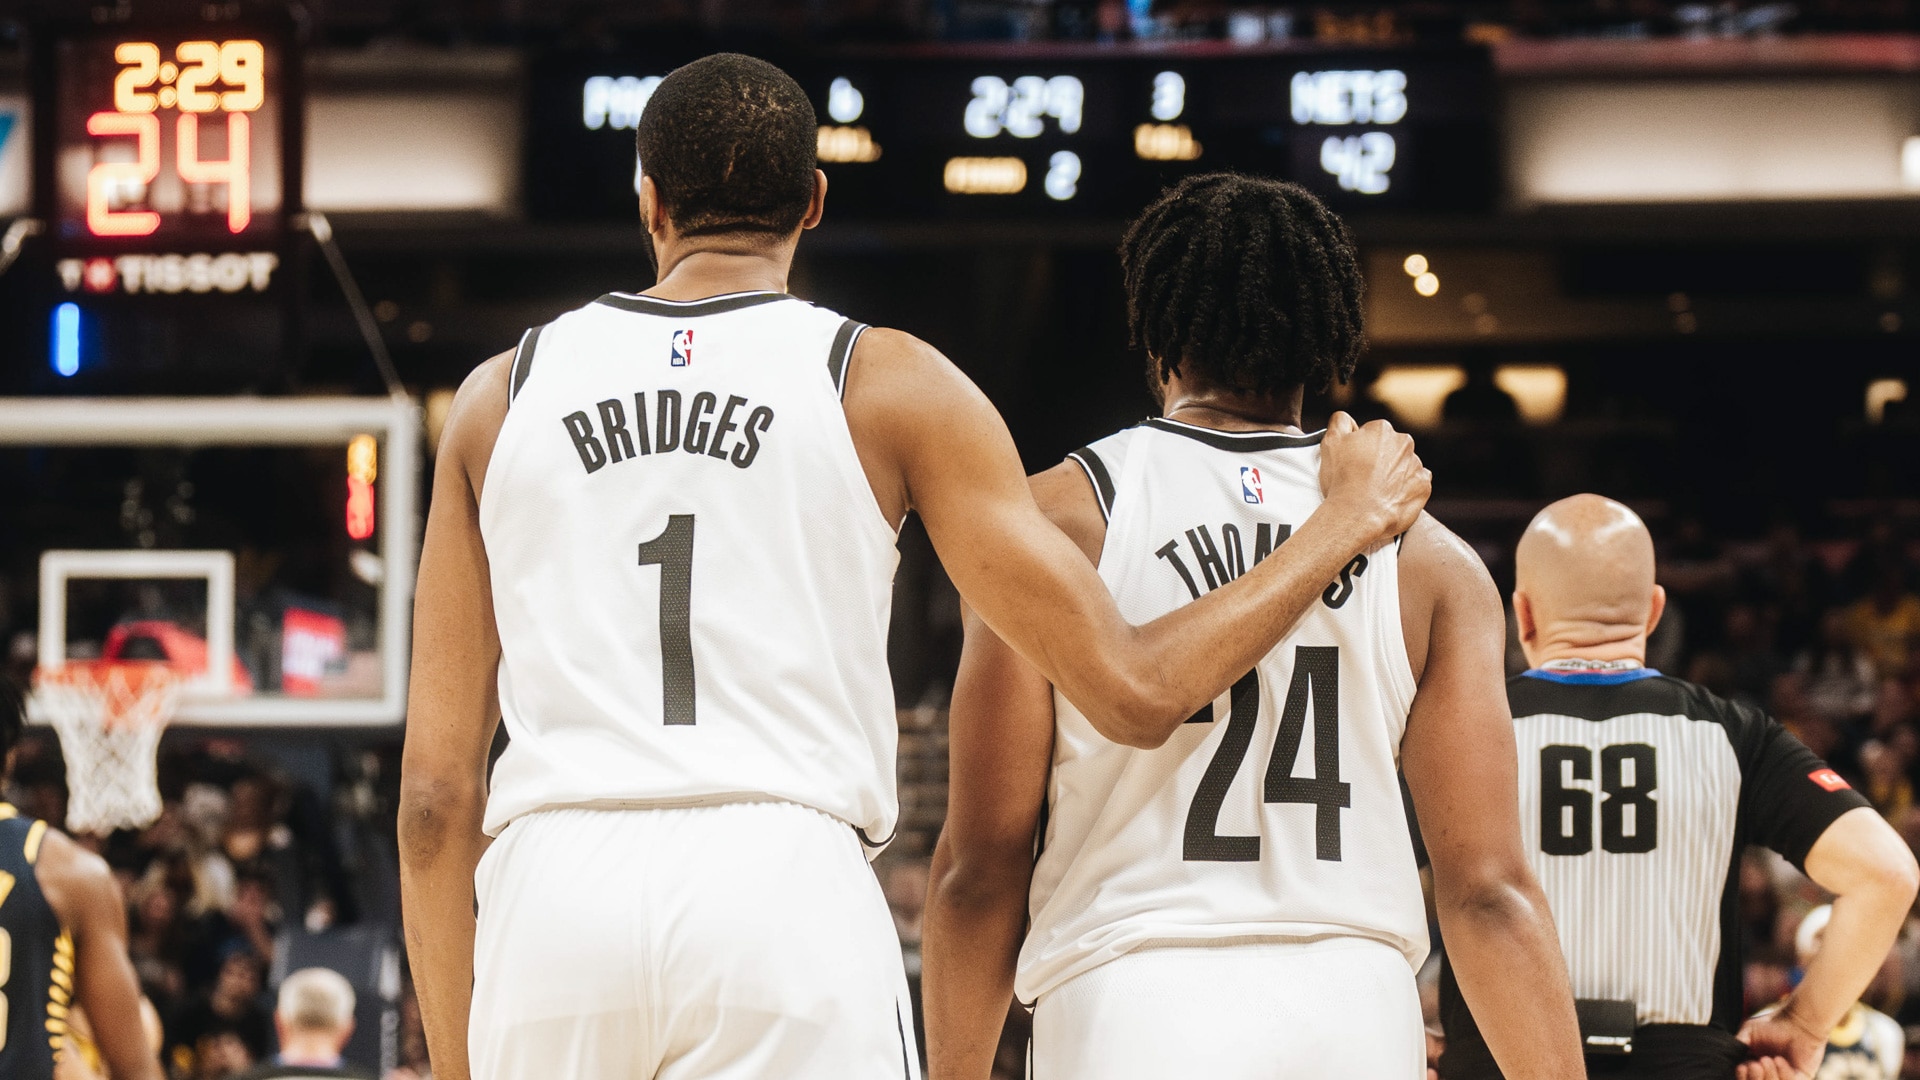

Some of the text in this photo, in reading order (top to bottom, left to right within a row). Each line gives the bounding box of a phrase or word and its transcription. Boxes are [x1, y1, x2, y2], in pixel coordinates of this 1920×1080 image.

[115, 40, 264, 113] 2:29
[964, 75, 1084, 138] 2:29
[1151, 71, 1186, 121] 3
[1290, 70, 1407, 125] NETS
[87, 111, 250, 236] 24
[1045, 150, 1081, 200] 2
[1320, 131, 1396, 194] 42
[117, 252, 279, 293] TISSOT
[561, 389, 775, 475] BRIDGES
[638, 513, 697, 726] 1
[1183, 645, 1351, 862] 24
[1540, 742, 1658, 856] 68
